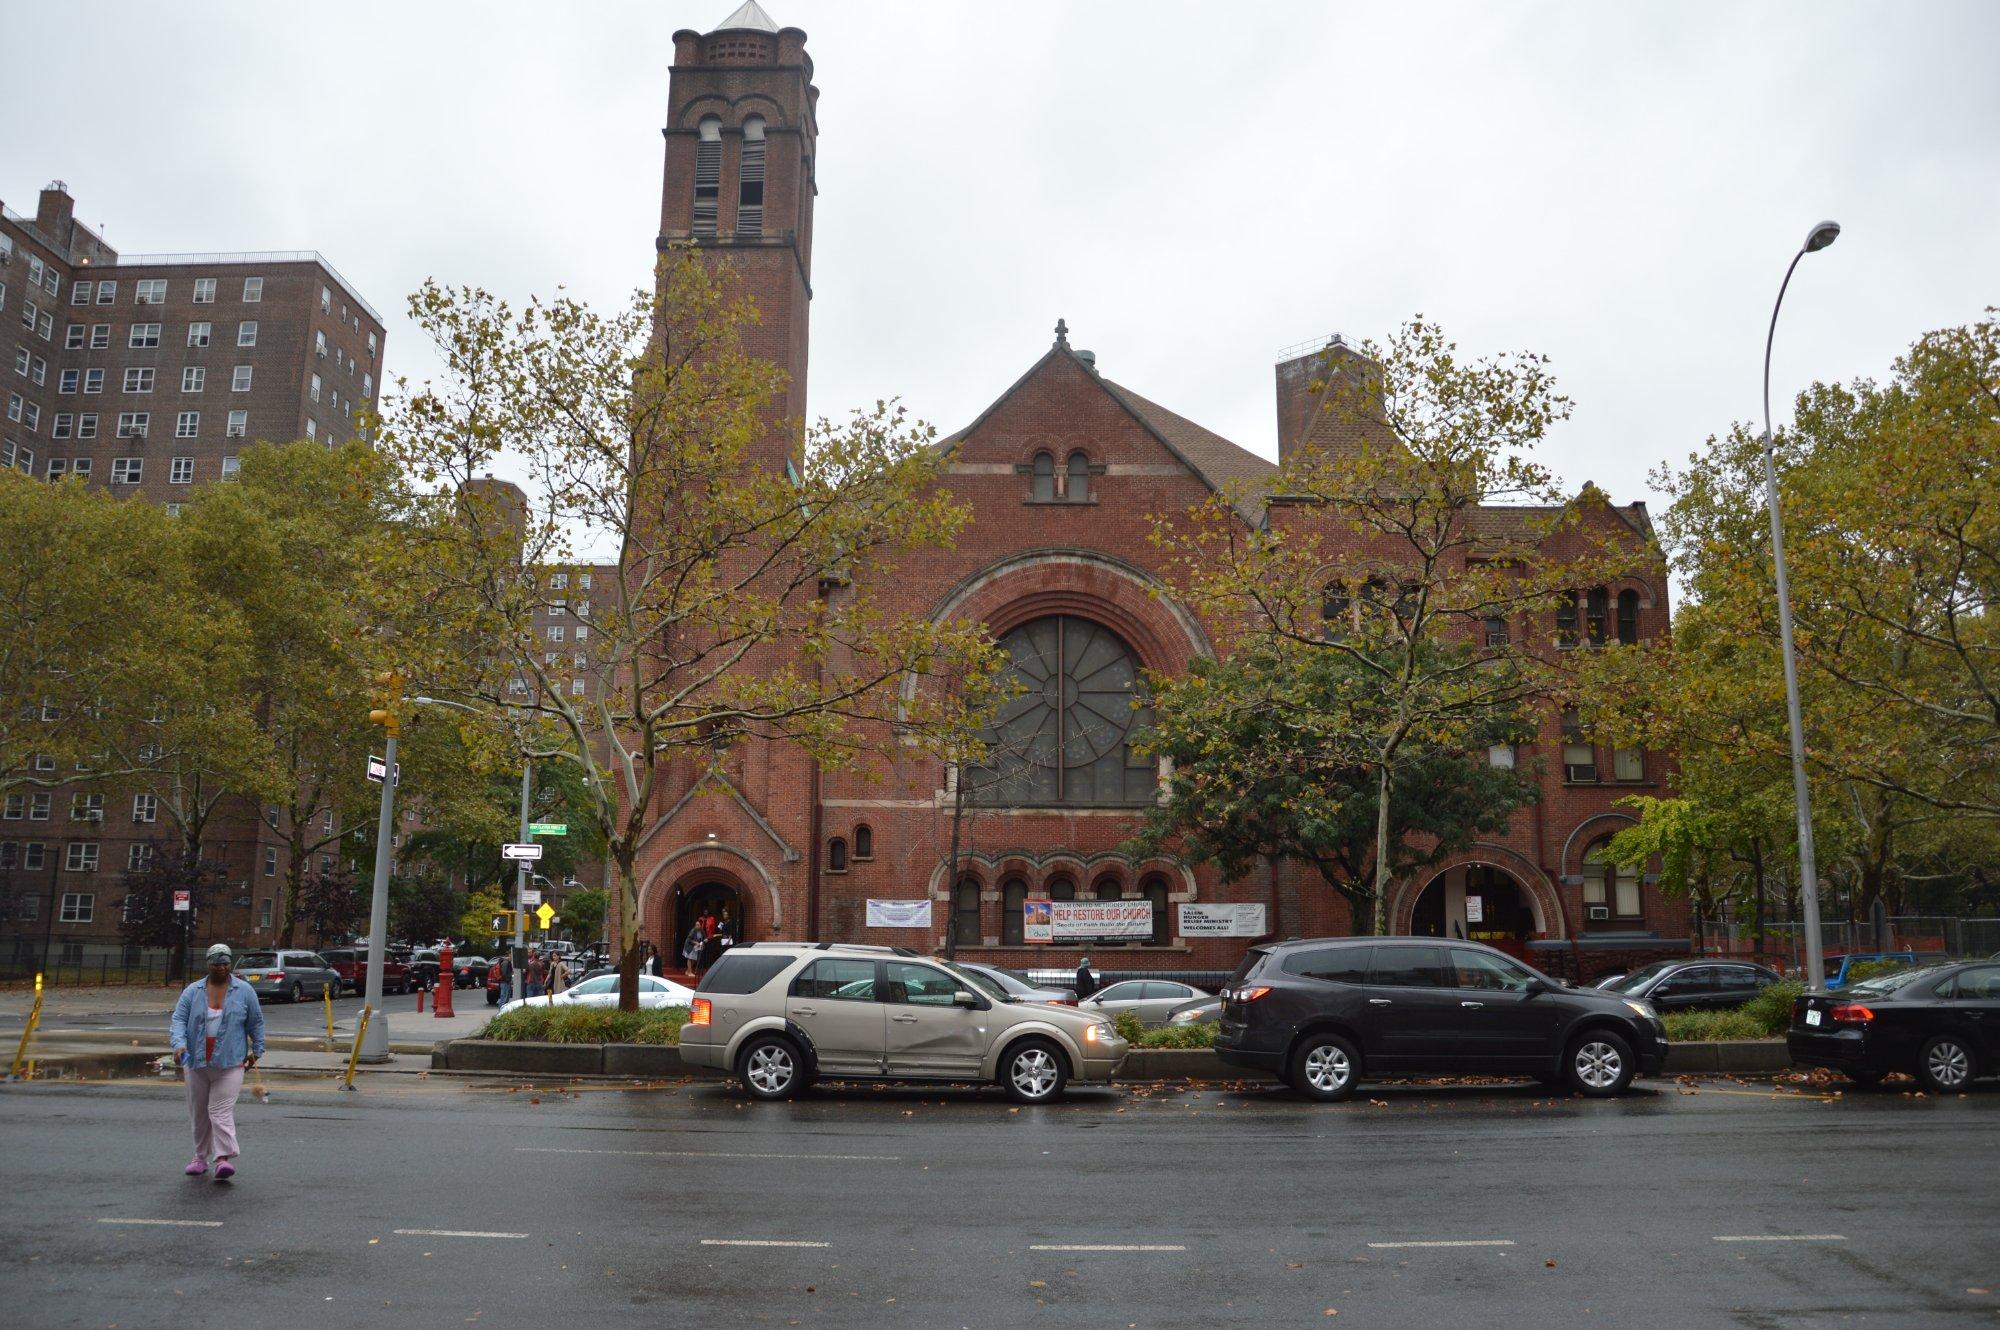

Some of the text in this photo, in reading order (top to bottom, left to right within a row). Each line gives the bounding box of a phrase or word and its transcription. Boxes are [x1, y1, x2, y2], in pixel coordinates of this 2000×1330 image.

[1053, 908, 1150, 920] HELP RESTORE OUR CHURCH
